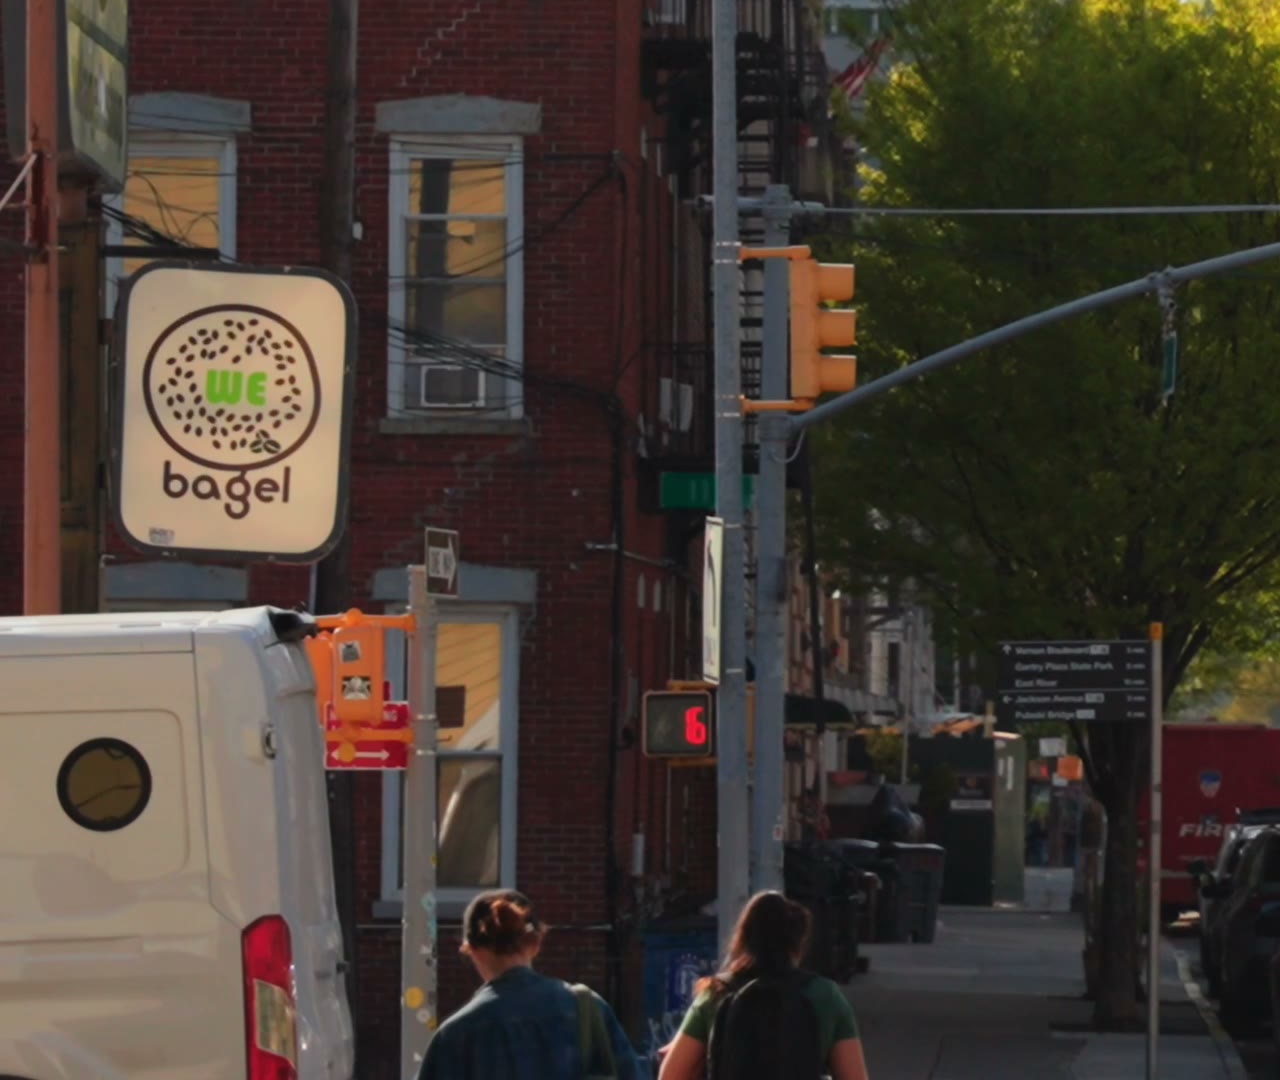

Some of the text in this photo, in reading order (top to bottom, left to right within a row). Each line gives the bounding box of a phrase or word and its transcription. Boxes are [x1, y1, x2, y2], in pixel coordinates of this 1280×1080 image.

[206, 369, 267, 407] WE
[162, 460, 291, 520] bagel
[684, 706, 707, 746] 6
